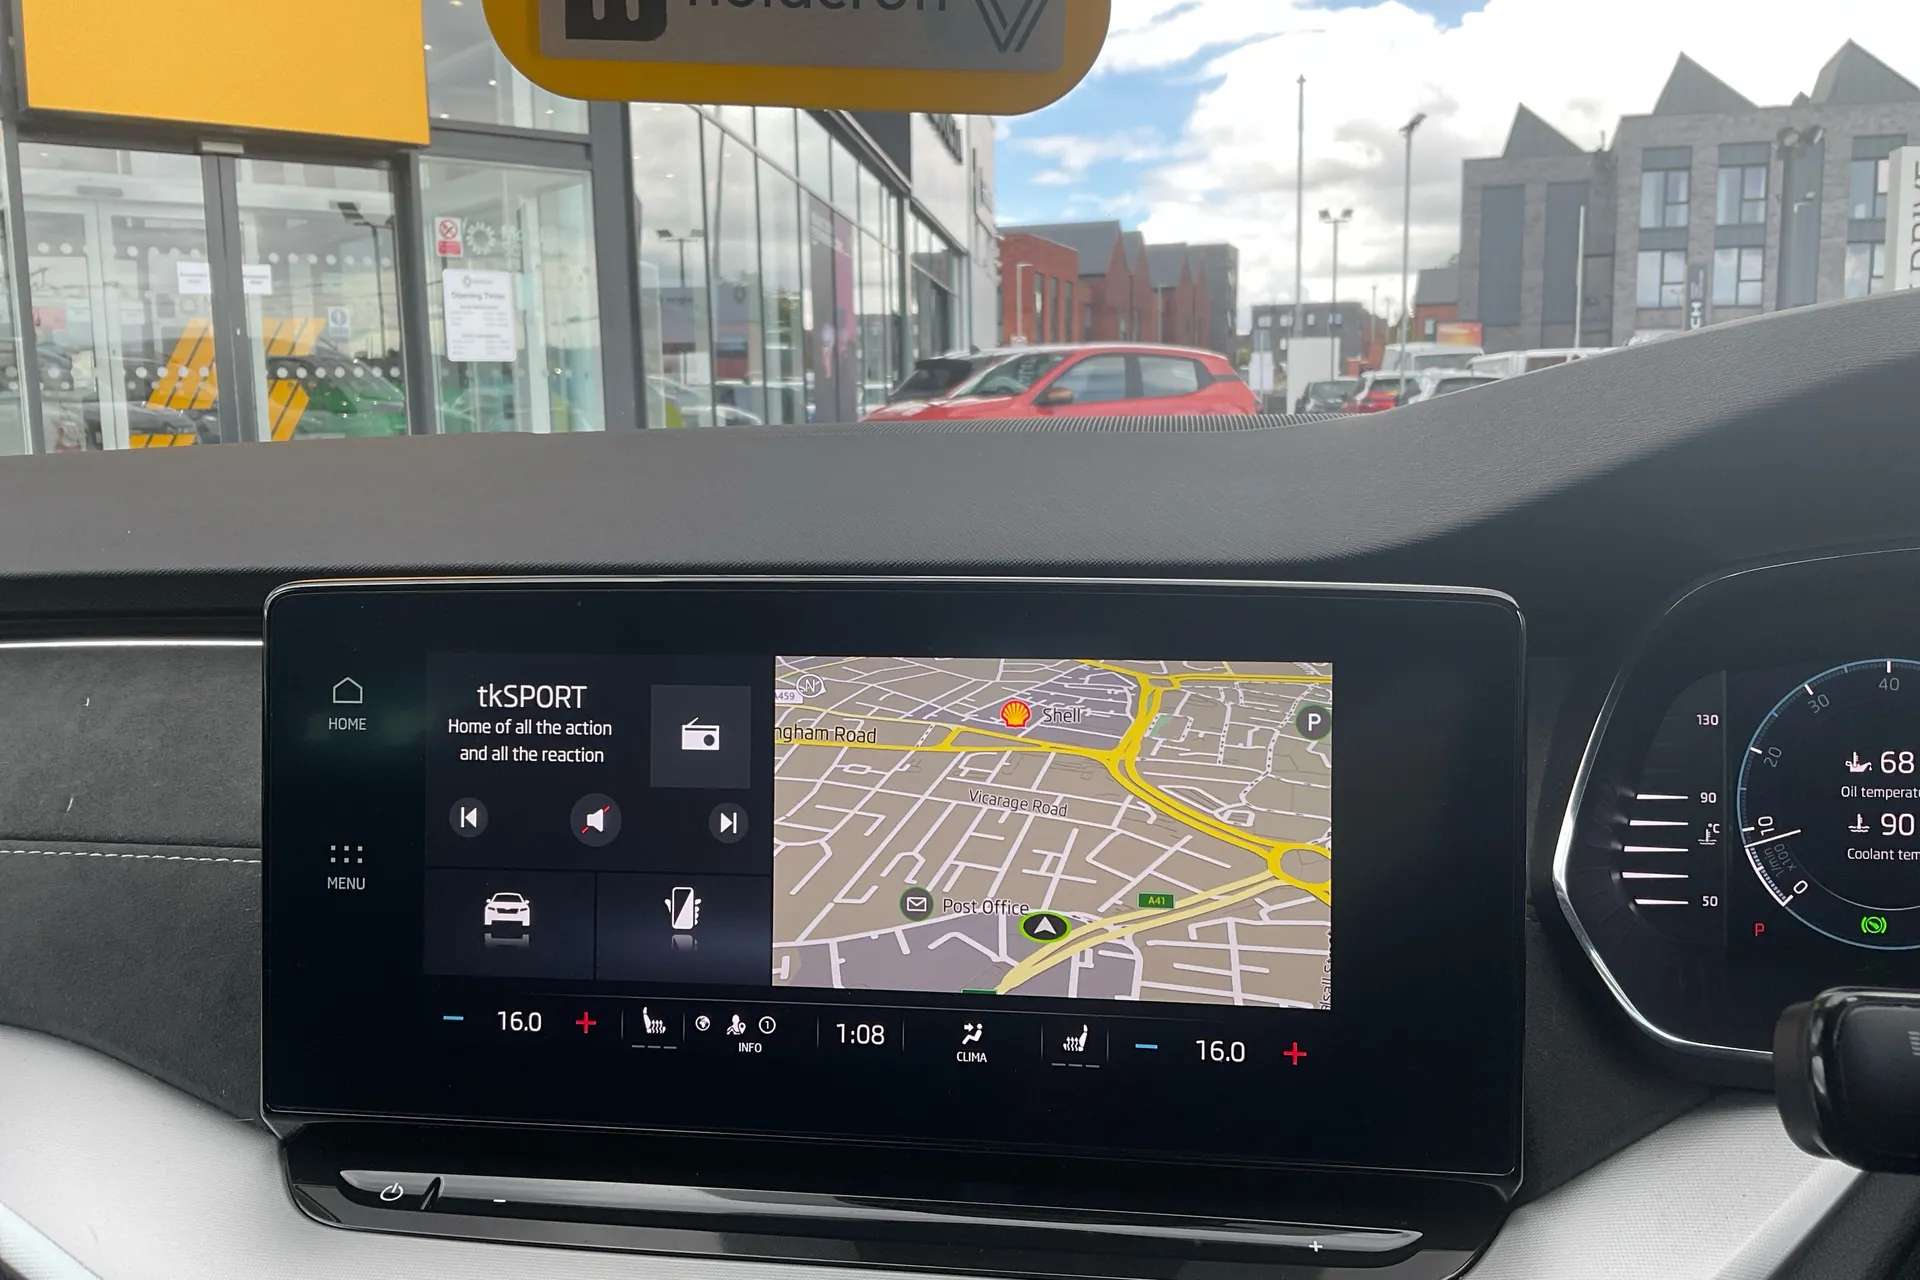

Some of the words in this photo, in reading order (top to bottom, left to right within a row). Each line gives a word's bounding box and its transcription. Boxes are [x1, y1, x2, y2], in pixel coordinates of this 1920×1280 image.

[1878, 677, 1900, 691] 40
[477, 683, 588, 708] tkSPORT
[1808, 694, 1830, 713] 30
[328, 717, 367, 731] HOME
[1042, 707, 1081, 724] Shell
[1697, 714, 1719, 725] 130
[448, 719, 491, 734] Home
[495, 719, 512, 734] of
[515, 719, 533, 735] all
[536, 720, 562, 735] the
[565, 720, 612, 736] action
[774, 724, 829, 742] ngham
[835, 727, 877, 744] Road
[460, 745, 488, 761] and
[491, 746, 509, 761] all
[512, 746, 538, 762] the
[541, 747, 605, 763] reaction
[1764, 746, 1782, 768] 20
[1880, 751, 1915, 774] 68
[1700, 792, 1717, 803] 90
[1841, 786, 1857, 798] Oil
[969, 789, 1028, 811] Vicarage
[1032, 799, 1068, 817] Road
[1757, 816, 1775, 836] 10
[1880, 813, 1915, 836] 90
[1847, 848, 1894, 860] Coolant
[327, 877, 366, 890] MENU
[1793, 880, 1808, 894] 0
[943, 899, 976, 915] Post
[981, 899, 1030, 916] Office
[1148, 896, 1166, 907] A41
[1702, 896, 1718, 907] 50
[1755, 923, 1765, 936] P
[498, 1011, 542, 1032] 16.0
[836, 1023, 885, 1045] 1:08
[739, 1042, 762, 1053] INFO
[1196, 1040, 1246, 1063] 16.0
[956, 1051, 987, 1063] CLIMA
